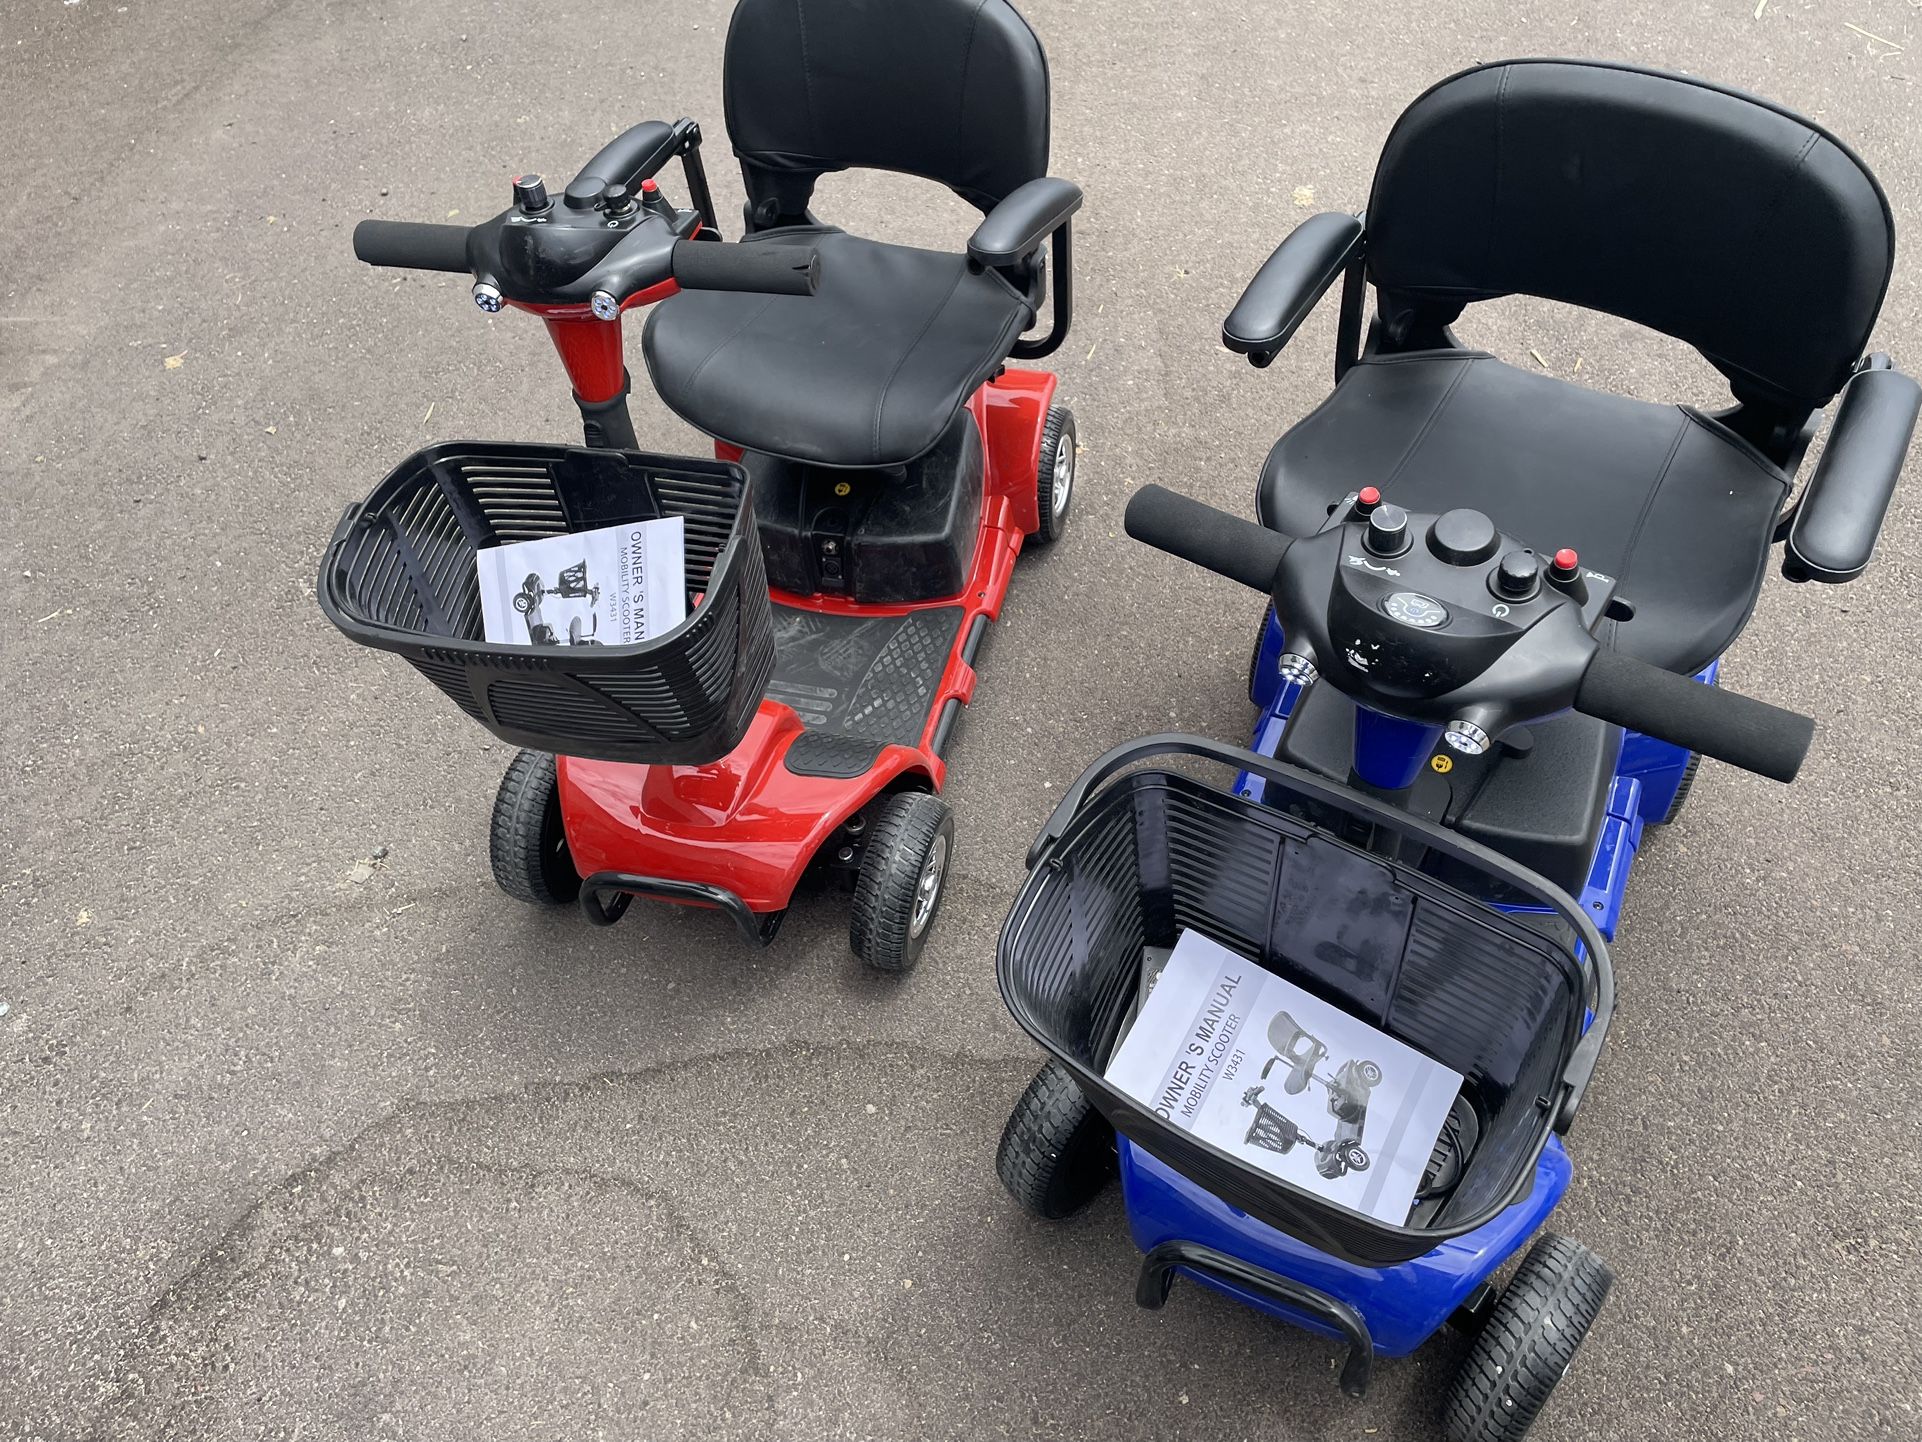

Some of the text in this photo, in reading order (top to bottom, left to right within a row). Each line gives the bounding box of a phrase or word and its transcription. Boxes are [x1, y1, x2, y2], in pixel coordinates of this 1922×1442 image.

[631, 531, 642, 587] OWNER
[609, 592, 617, 622] W3431
[620, 547, 631, 643] MOBILITY SCOOTER
[1195, 975, 1242, 1043] MANUAL
[1180, 1013, 1241, 1118] MOBILITY SCOOTER
[1222, 1049, 1246, 1081] W3431
